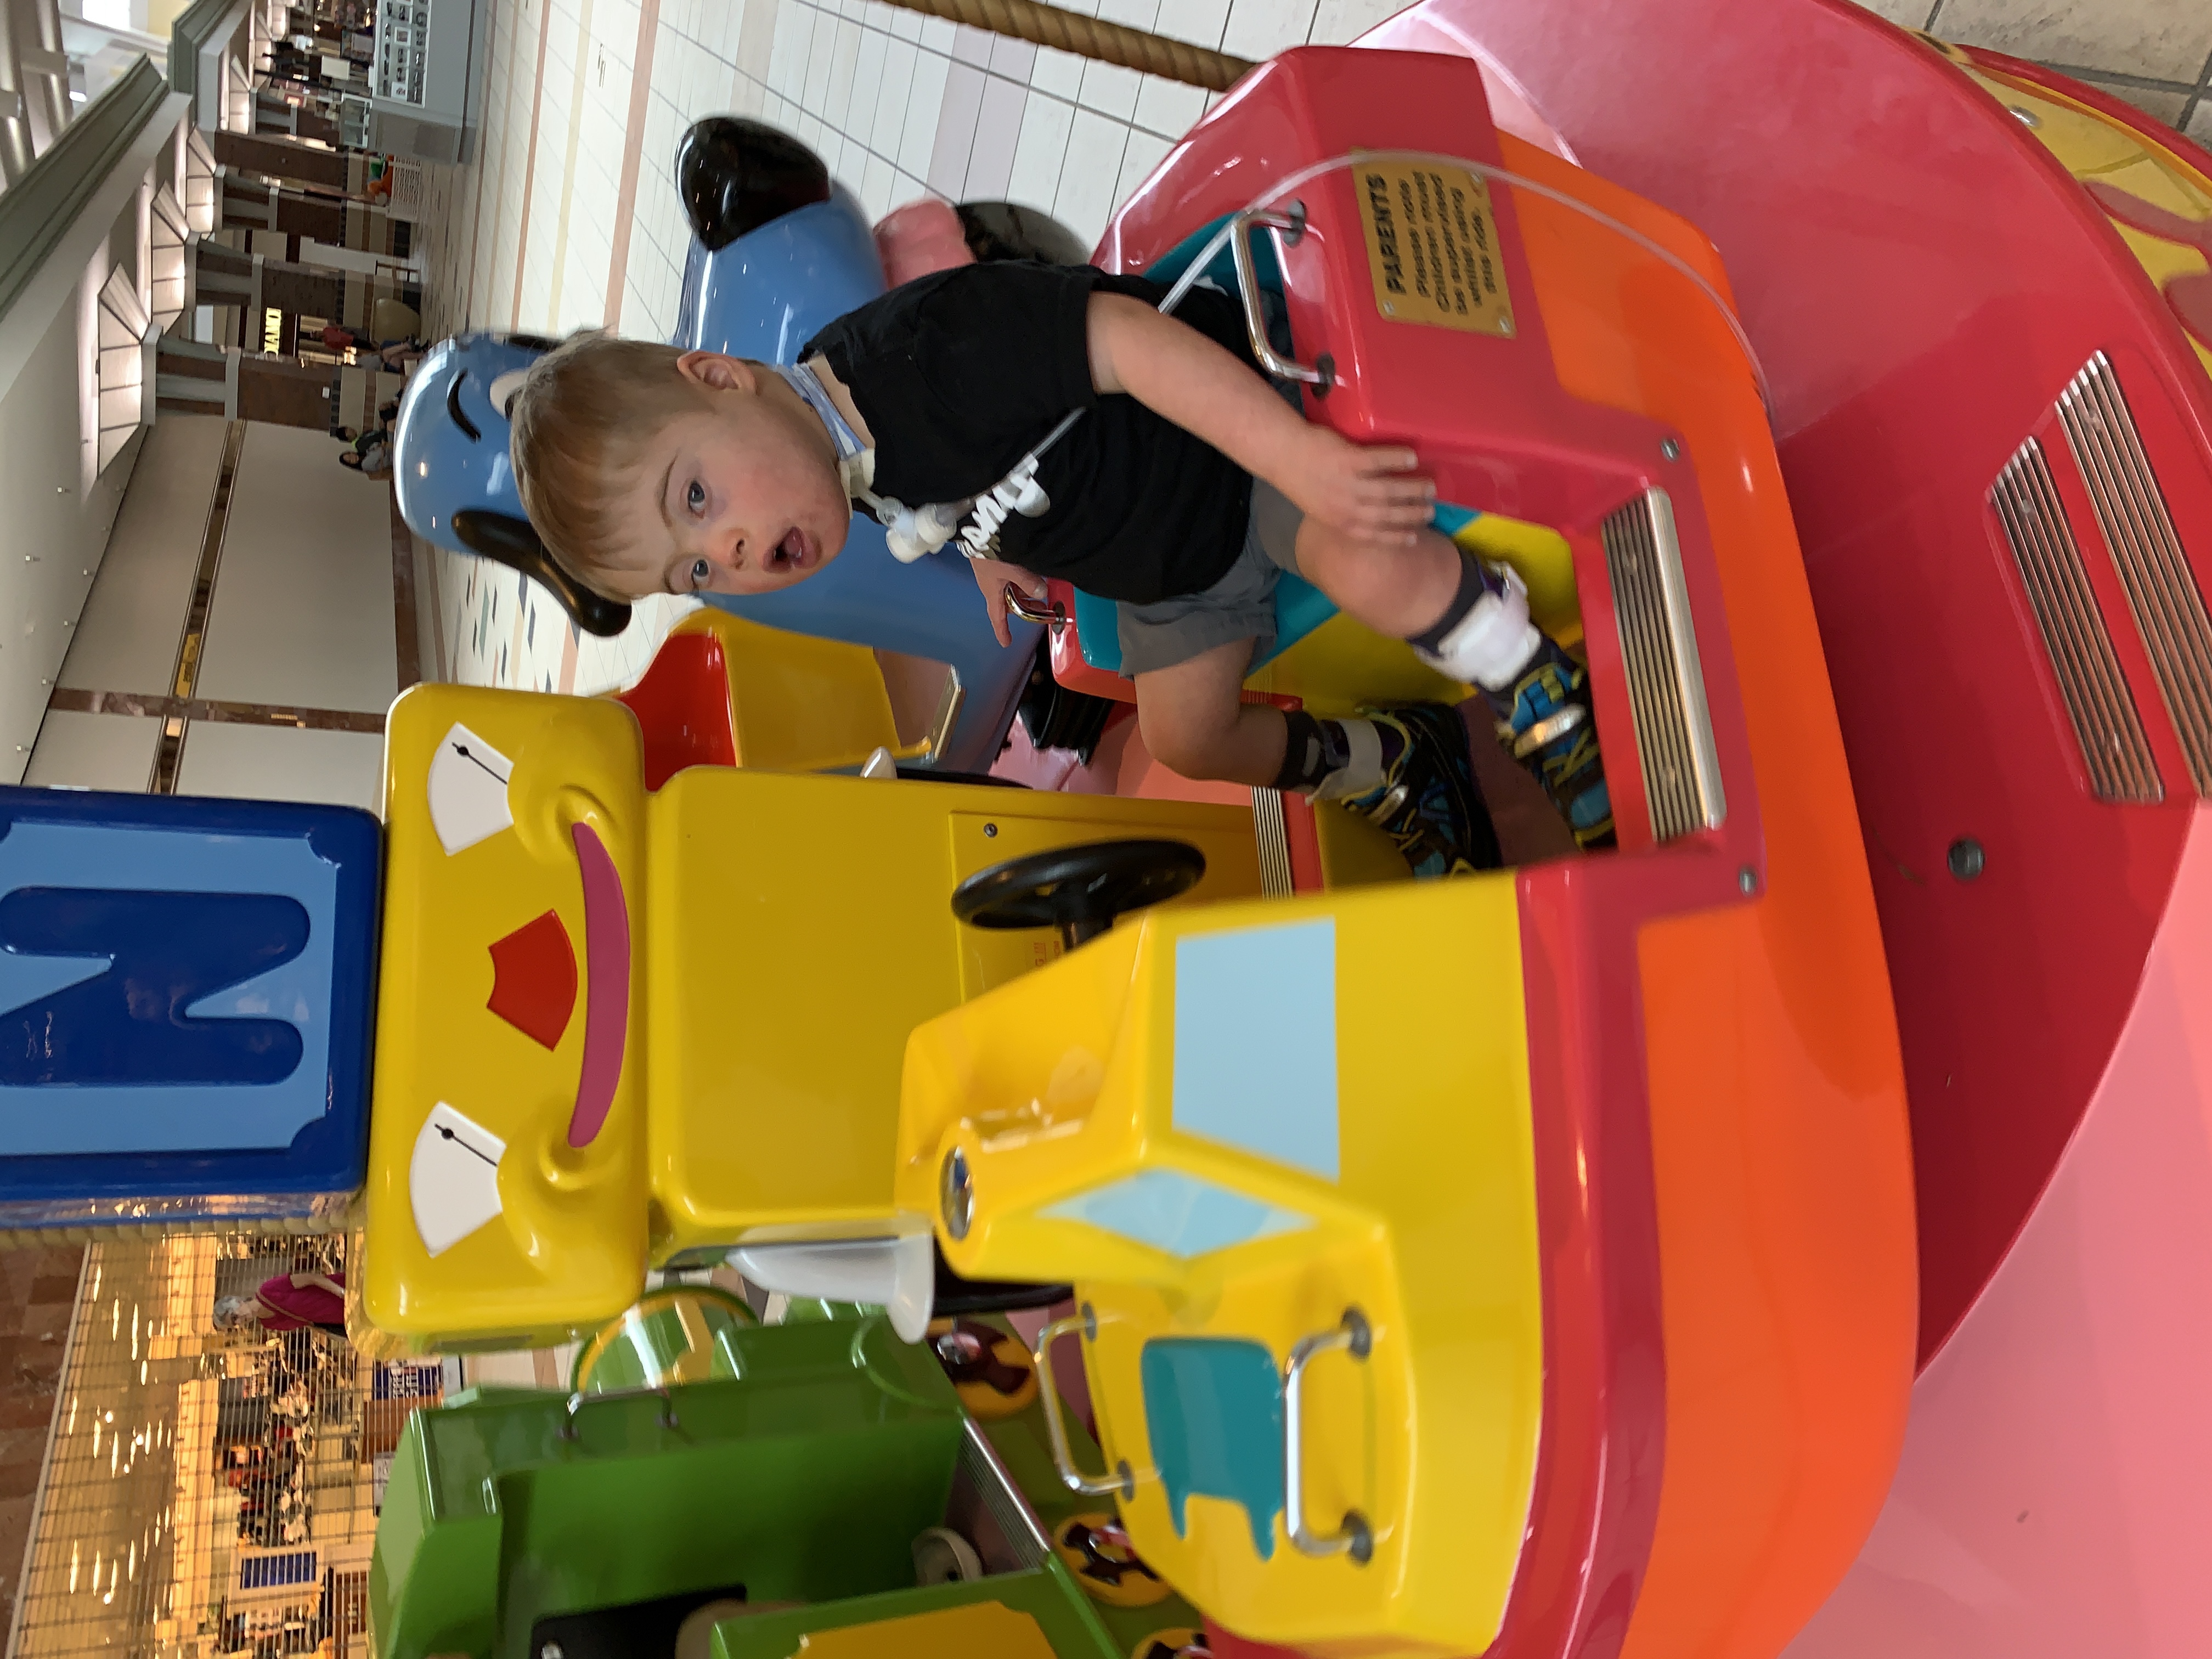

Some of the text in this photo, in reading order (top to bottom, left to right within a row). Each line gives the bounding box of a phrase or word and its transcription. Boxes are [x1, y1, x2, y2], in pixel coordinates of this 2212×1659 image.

[1367, 175, 1406, 294] PARENTS
[1400, 179, 1430, 296] Please note
[1414, 171, 1449, 312] Children must
[1430, 174, 1468, 314] be supervised
[1452, 188, 1470, 242] using
[0, 885, 311, 1086] N
